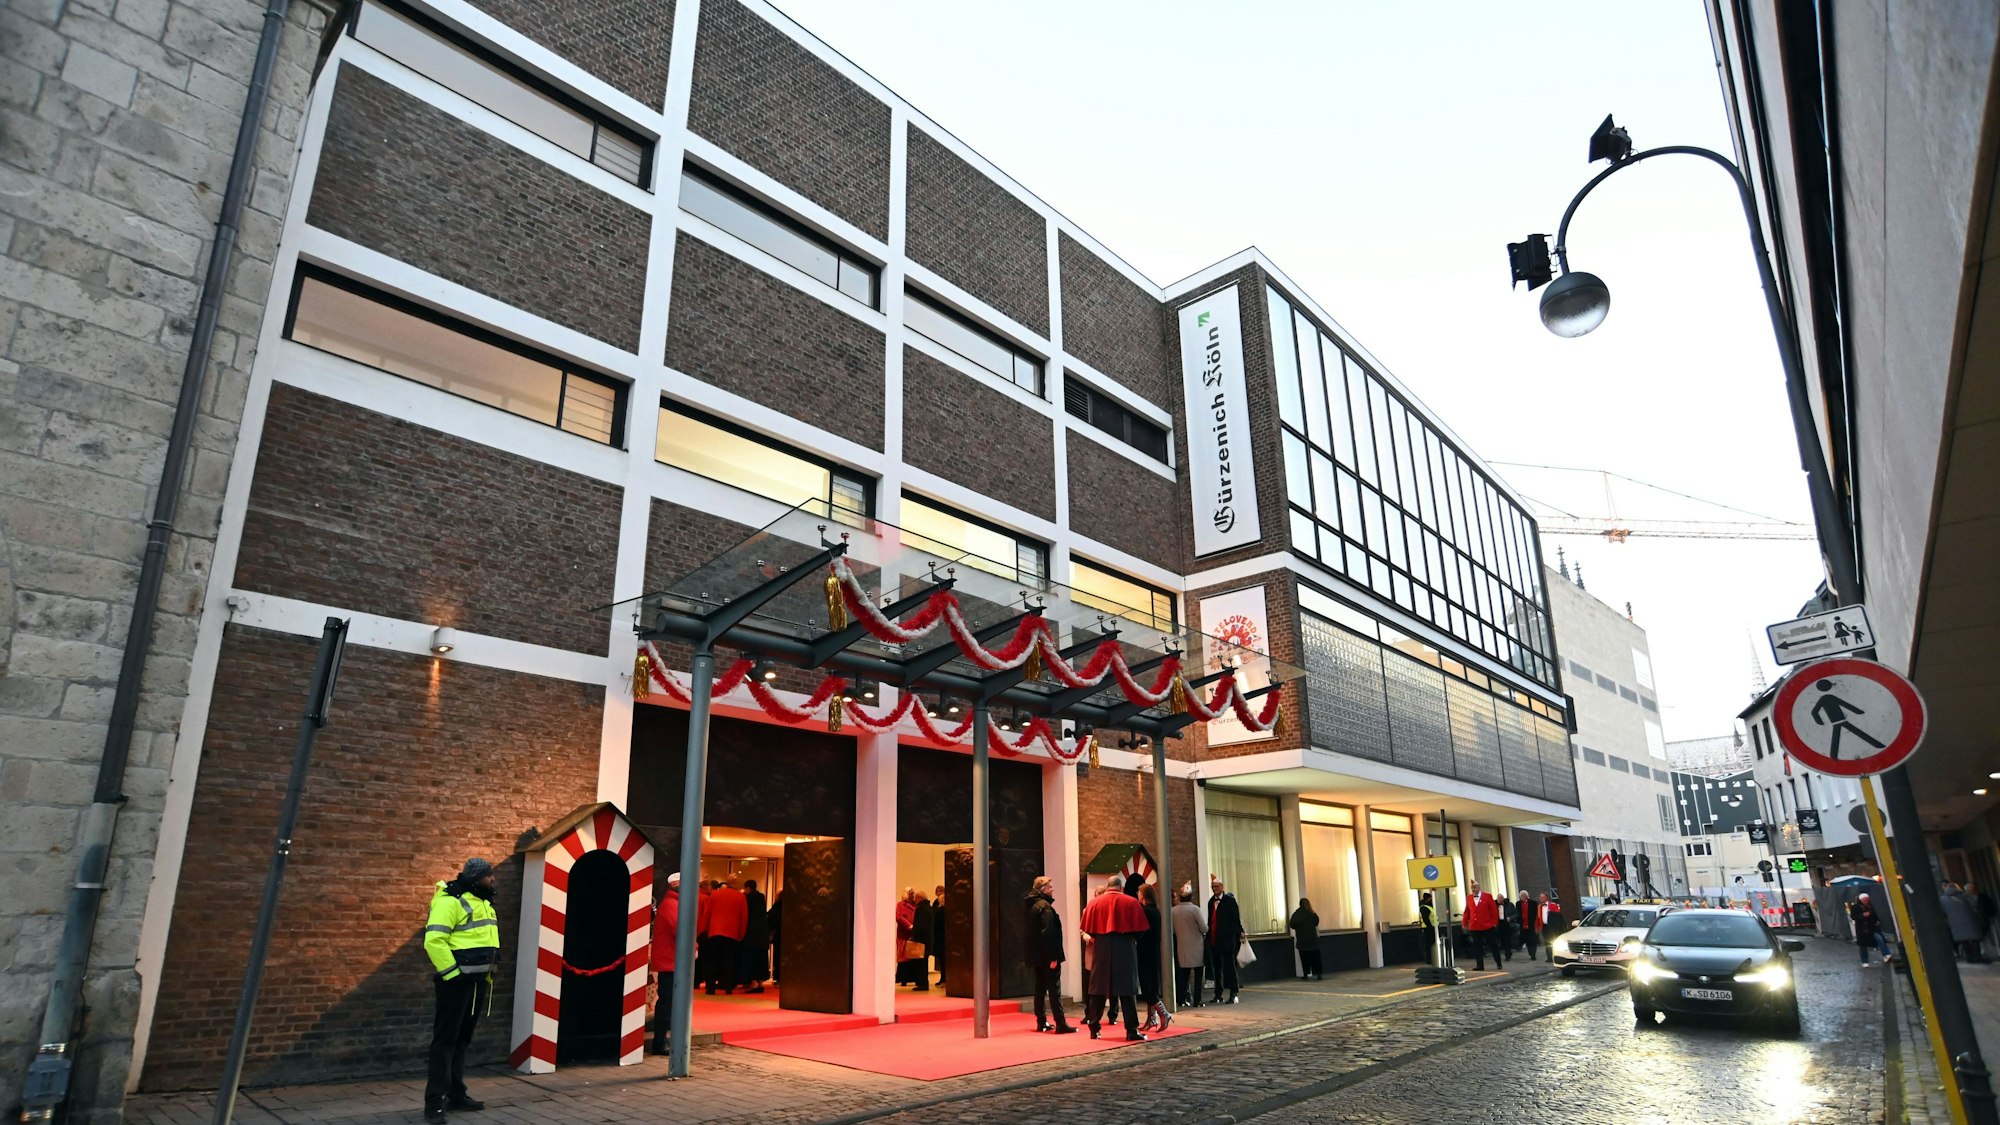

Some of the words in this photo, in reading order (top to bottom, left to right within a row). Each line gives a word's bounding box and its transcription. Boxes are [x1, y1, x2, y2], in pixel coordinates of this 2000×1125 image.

[1203, 326, 1223, 390] Köln
[1212, 392, 1237, 533] Gürzenich
[1697, 990, 1709, 998] SD
[1709, 991, 1731, 999] 6106
